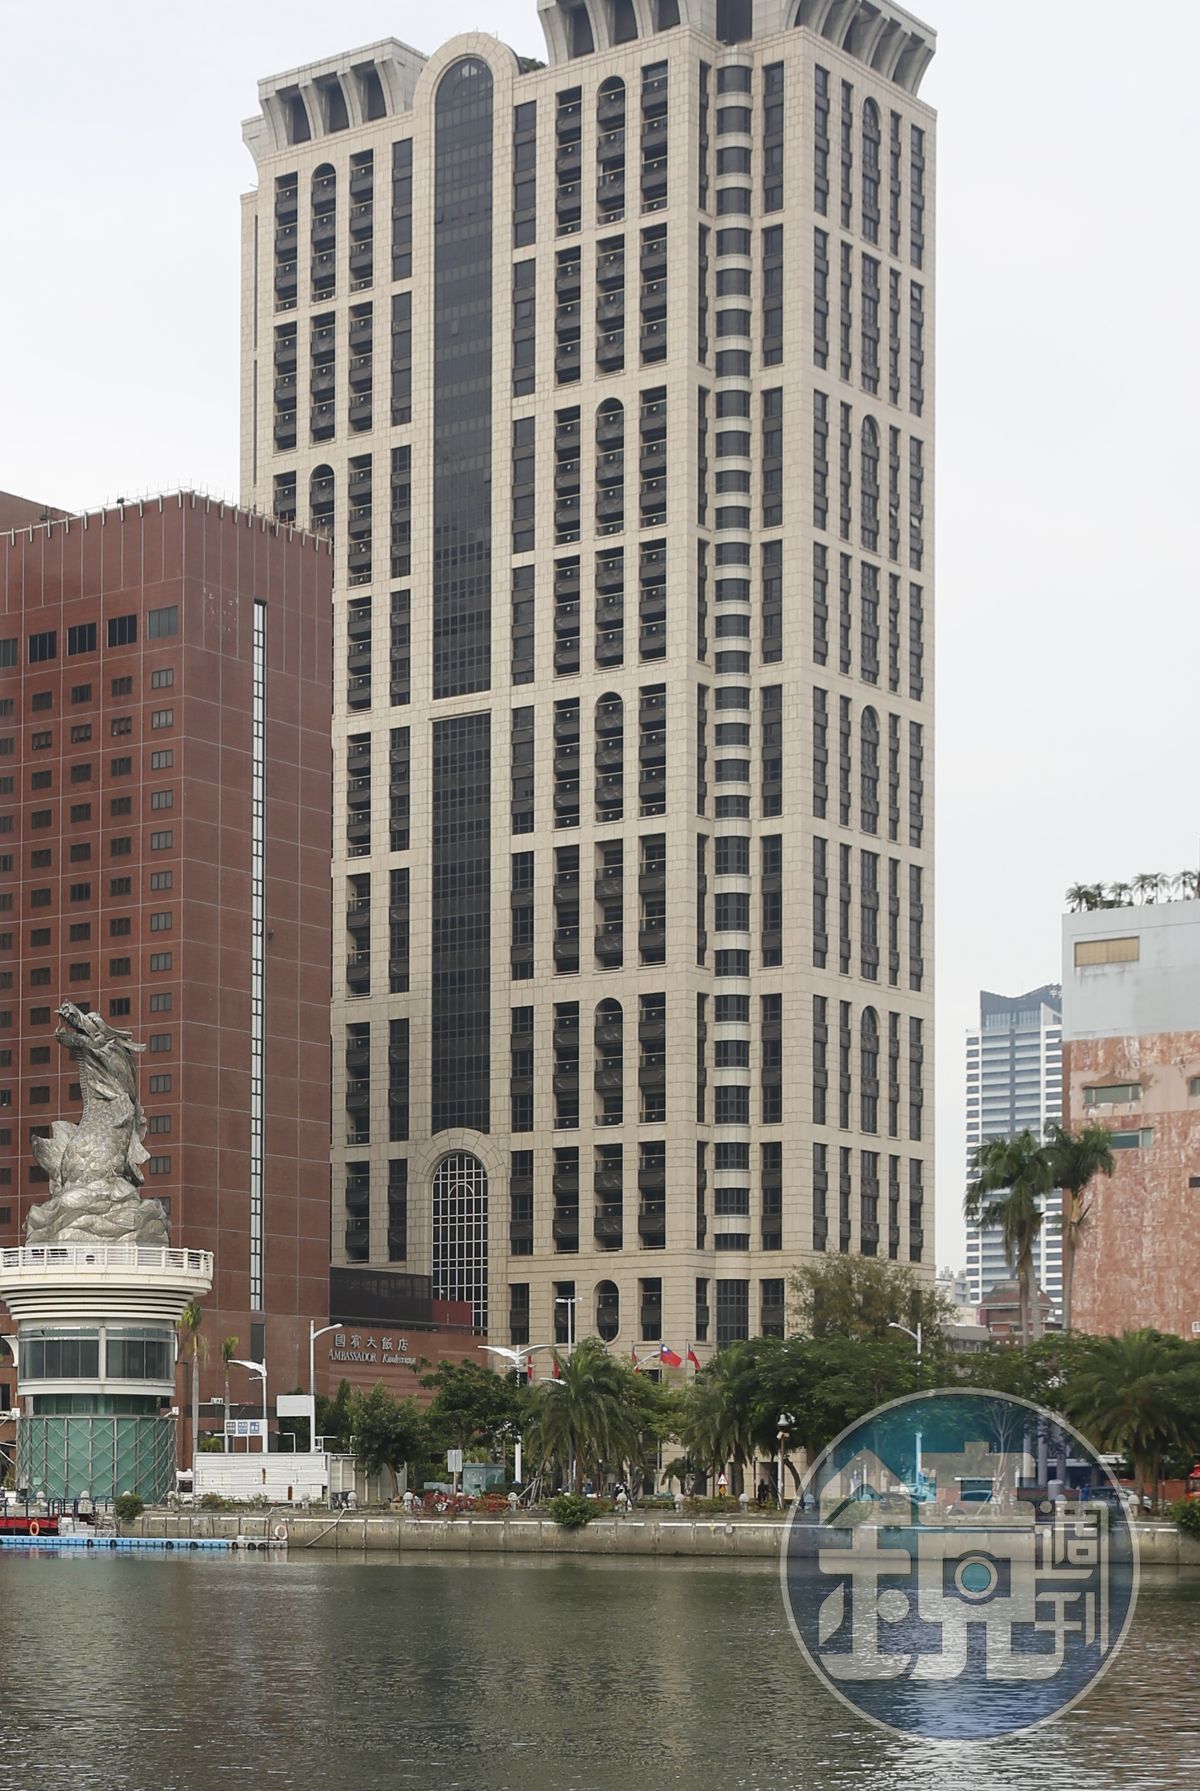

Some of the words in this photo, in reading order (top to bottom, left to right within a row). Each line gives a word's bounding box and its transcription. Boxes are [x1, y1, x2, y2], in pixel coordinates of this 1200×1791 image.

[335, 1333, 409, 1352] 國賓大飯店
[328, 1347, 377, 1363] AMBASSADOR
